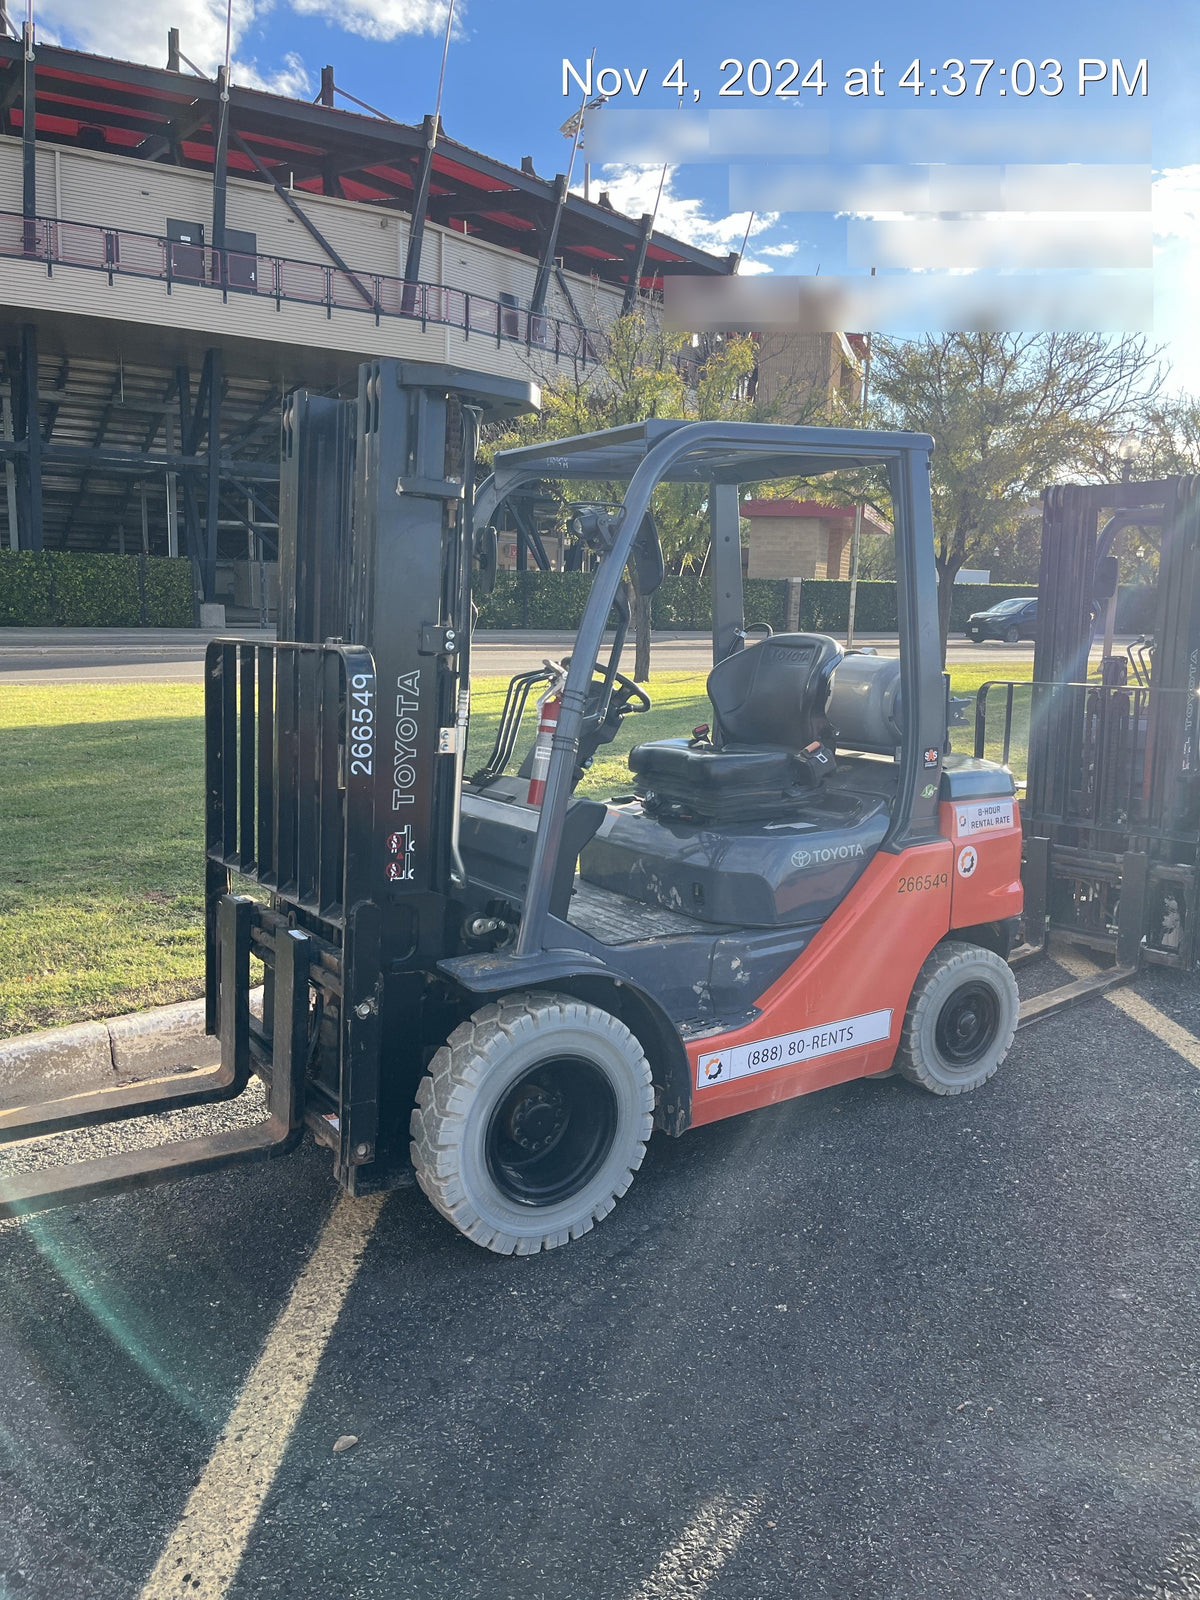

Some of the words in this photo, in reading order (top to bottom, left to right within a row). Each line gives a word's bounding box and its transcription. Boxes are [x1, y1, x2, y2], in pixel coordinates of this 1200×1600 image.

[1185, 648, 1199, 731] TOYOTA
[351, 673, 373, 775] 266549
[392, 669, 421, 811] TOYOTA
[970, 818, 994, 829] RENTAL
[995, 815, 1011, 825] RATE
[977, 805, 1001, 816] 8-HOUR
[813, 843, 865, 863] TOYOTA
[897, 873, 948, 894] 266549
[747, 1044, 783, 1069] (888)
[788, 1026, 854, 1056] 80-RENTS
